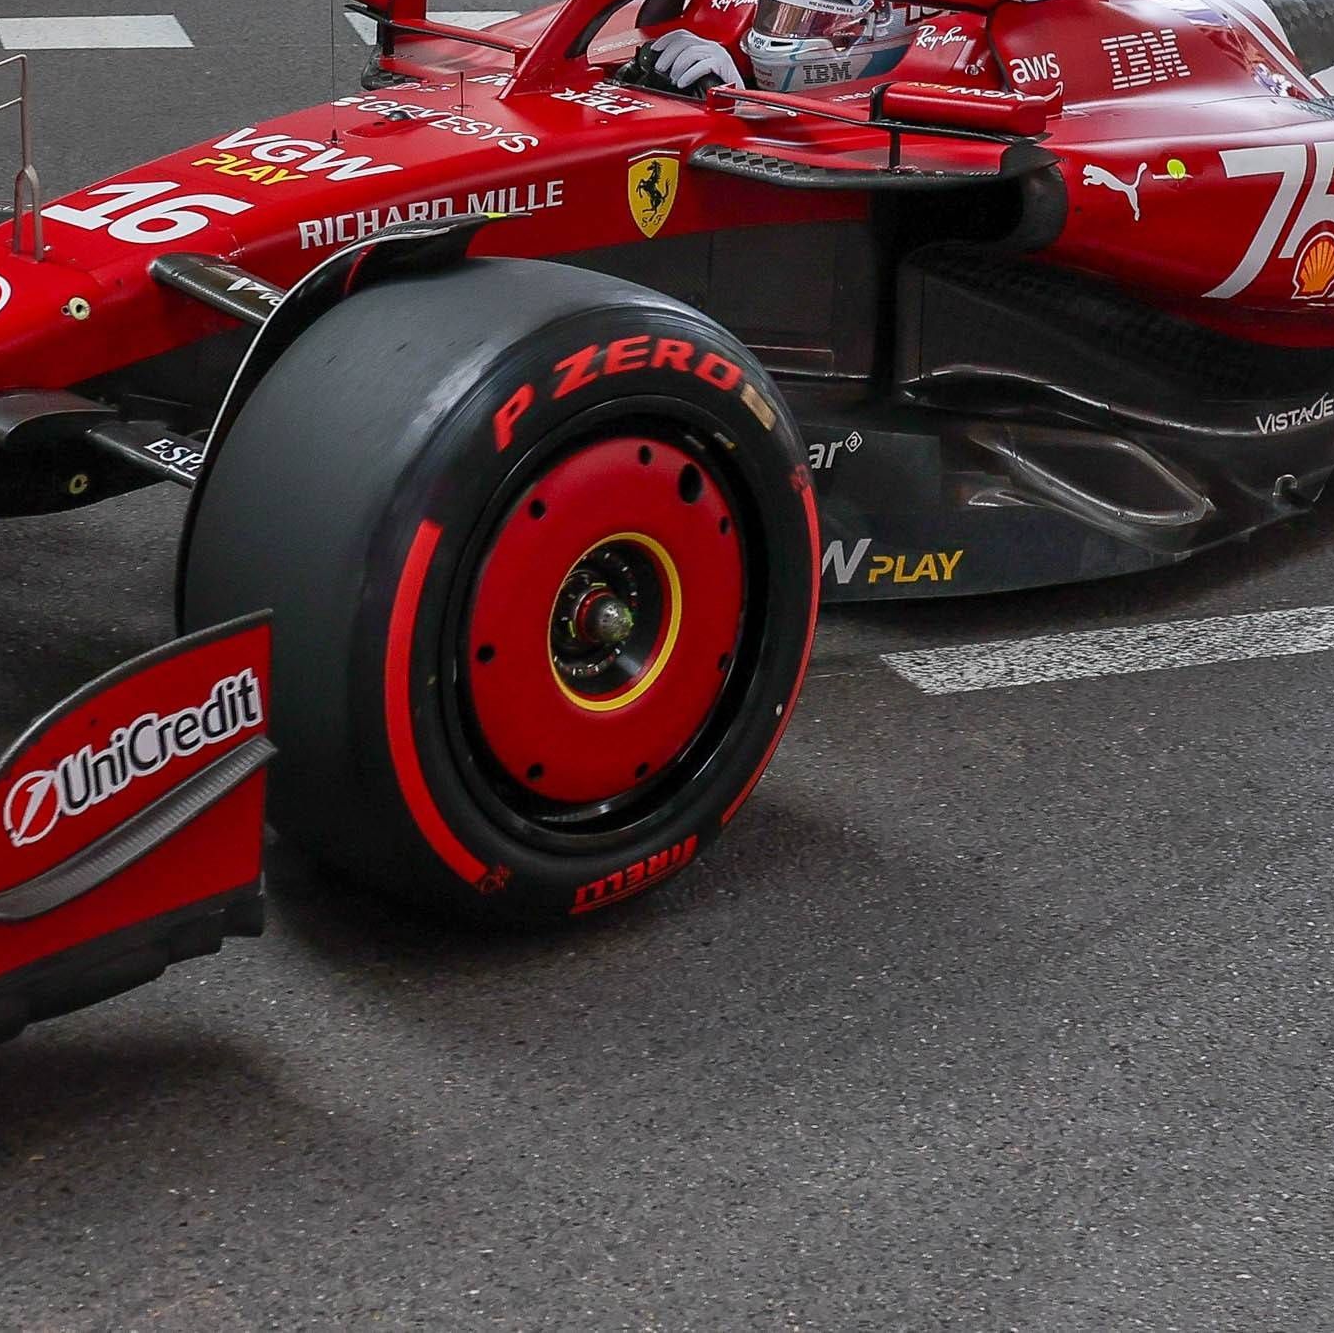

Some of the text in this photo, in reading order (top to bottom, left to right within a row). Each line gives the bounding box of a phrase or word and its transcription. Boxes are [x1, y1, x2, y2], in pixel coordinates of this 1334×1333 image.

[803, 61, 852, 84] IBM
[1009, 53, 1061, 85] aws
[1101, 28, 1191, 91] IBM
[191, 153, 308, 185] PLAY
[212, 127, 403, 181] VGW
[41, 180, 255, 244] 16
[298, 179, 565, 250] RICHARD MILLE
[492, 334, 745, 454] P ZERO
[867, 550, 964, 584] PLAY
[59, 668, 263, 815] UniCredit
[569, 834, 699, 915] PIRELLI
